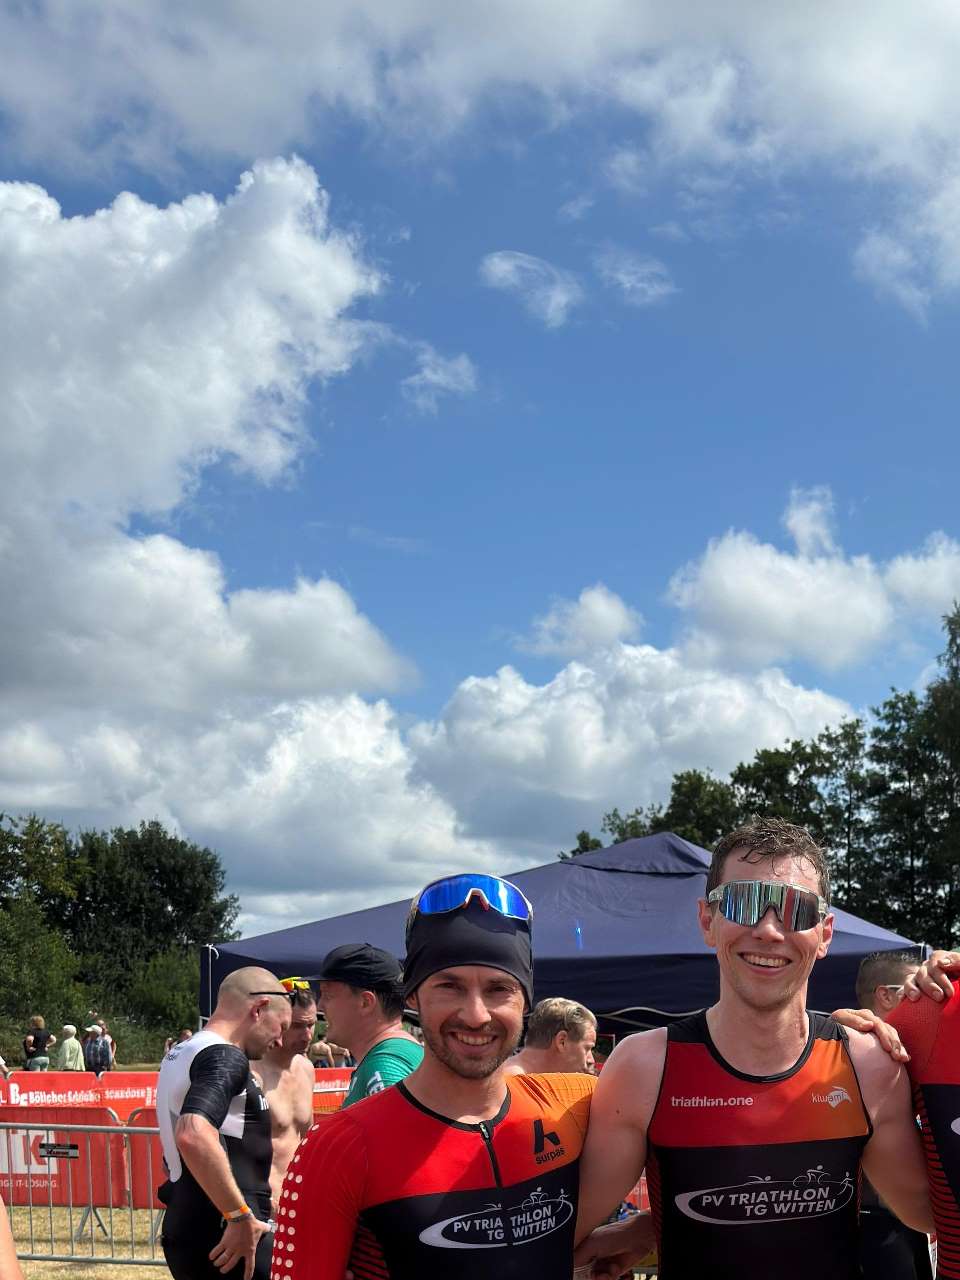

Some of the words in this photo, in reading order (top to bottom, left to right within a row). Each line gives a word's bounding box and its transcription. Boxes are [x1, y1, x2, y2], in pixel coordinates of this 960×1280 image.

[671, 1095, 753, 1108] triathlon.one
[535, 1147, 566, 1164] surpas
[702, 1194, 724, 1207] PV
[729, 1186, 830, 1206] TRIATHLON
[744, 1205, 768, 1216] TG
[774, 1199, 836, 1214] WITTEN
[453, 1221, 471, 1233] PV
[487, 1229, 505, 1240] TG
[512, 1216, 556, 1238] WITTEN
